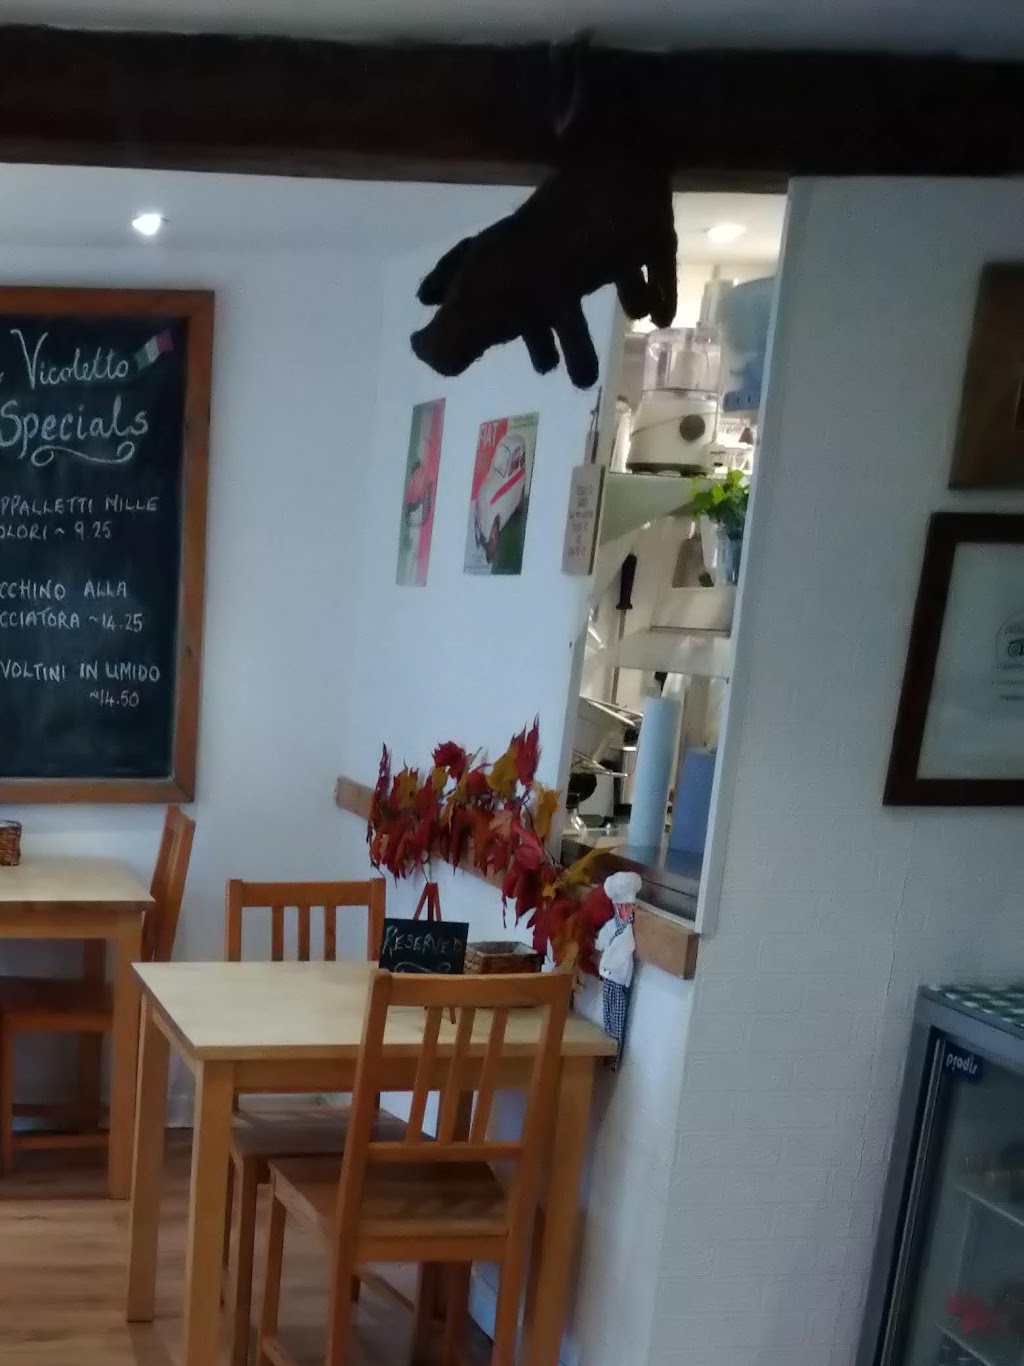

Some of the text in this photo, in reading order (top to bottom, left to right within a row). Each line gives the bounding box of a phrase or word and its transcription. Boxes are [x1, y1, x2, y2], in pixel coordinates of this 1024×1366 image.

[10, 328, 129, 390] Vicoletto
[105, 494, 160, 512] MILLE
[83, 580, 128, 599] ALLA
[79, 660, 99, 681] IN
[105, 660, 161, 683] UMIDO
